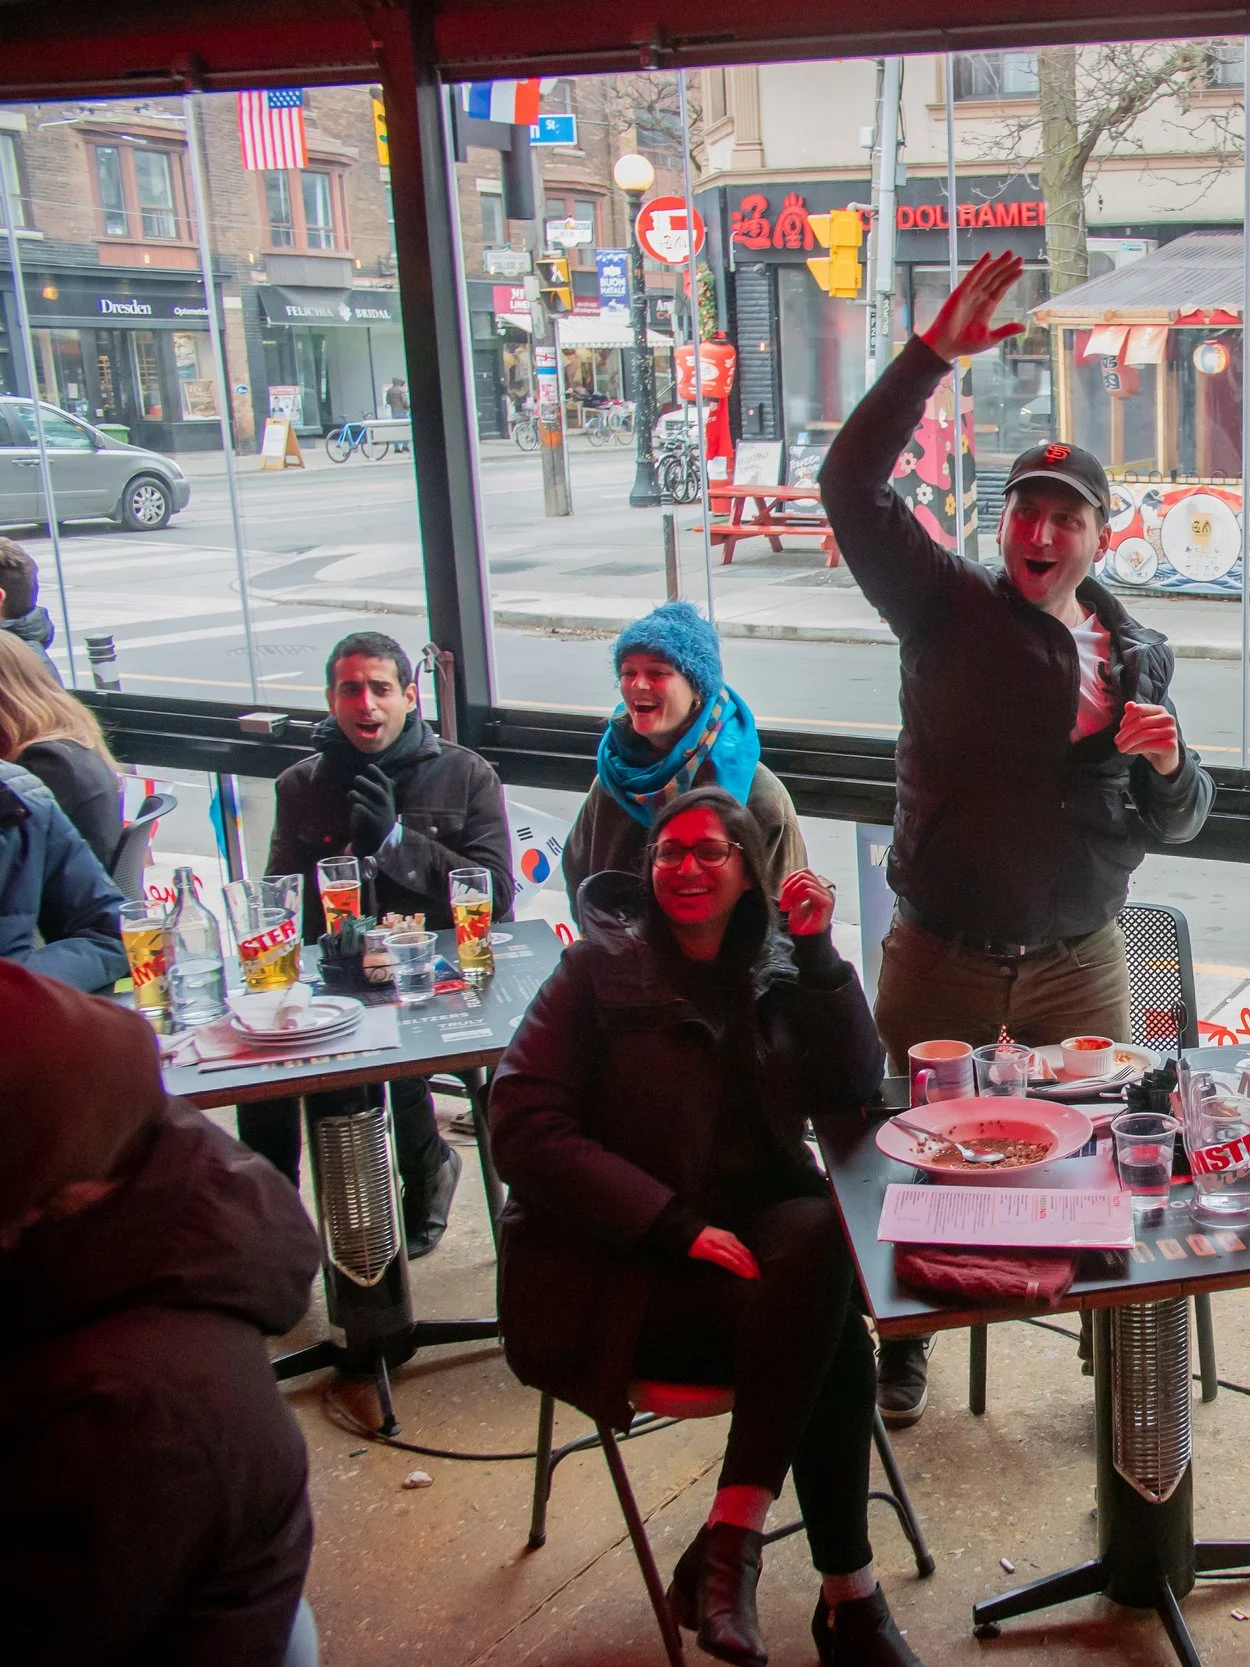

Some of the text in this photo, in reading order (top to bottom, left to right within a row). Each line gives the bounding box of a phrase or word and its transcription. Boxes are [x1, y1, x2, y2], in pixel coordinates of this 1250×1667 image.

[100, 299, 152, 315] Dresden
[355, 308, 391, 320] BRIDAL
[401, 1012, 470, 1025] ELTZERS
